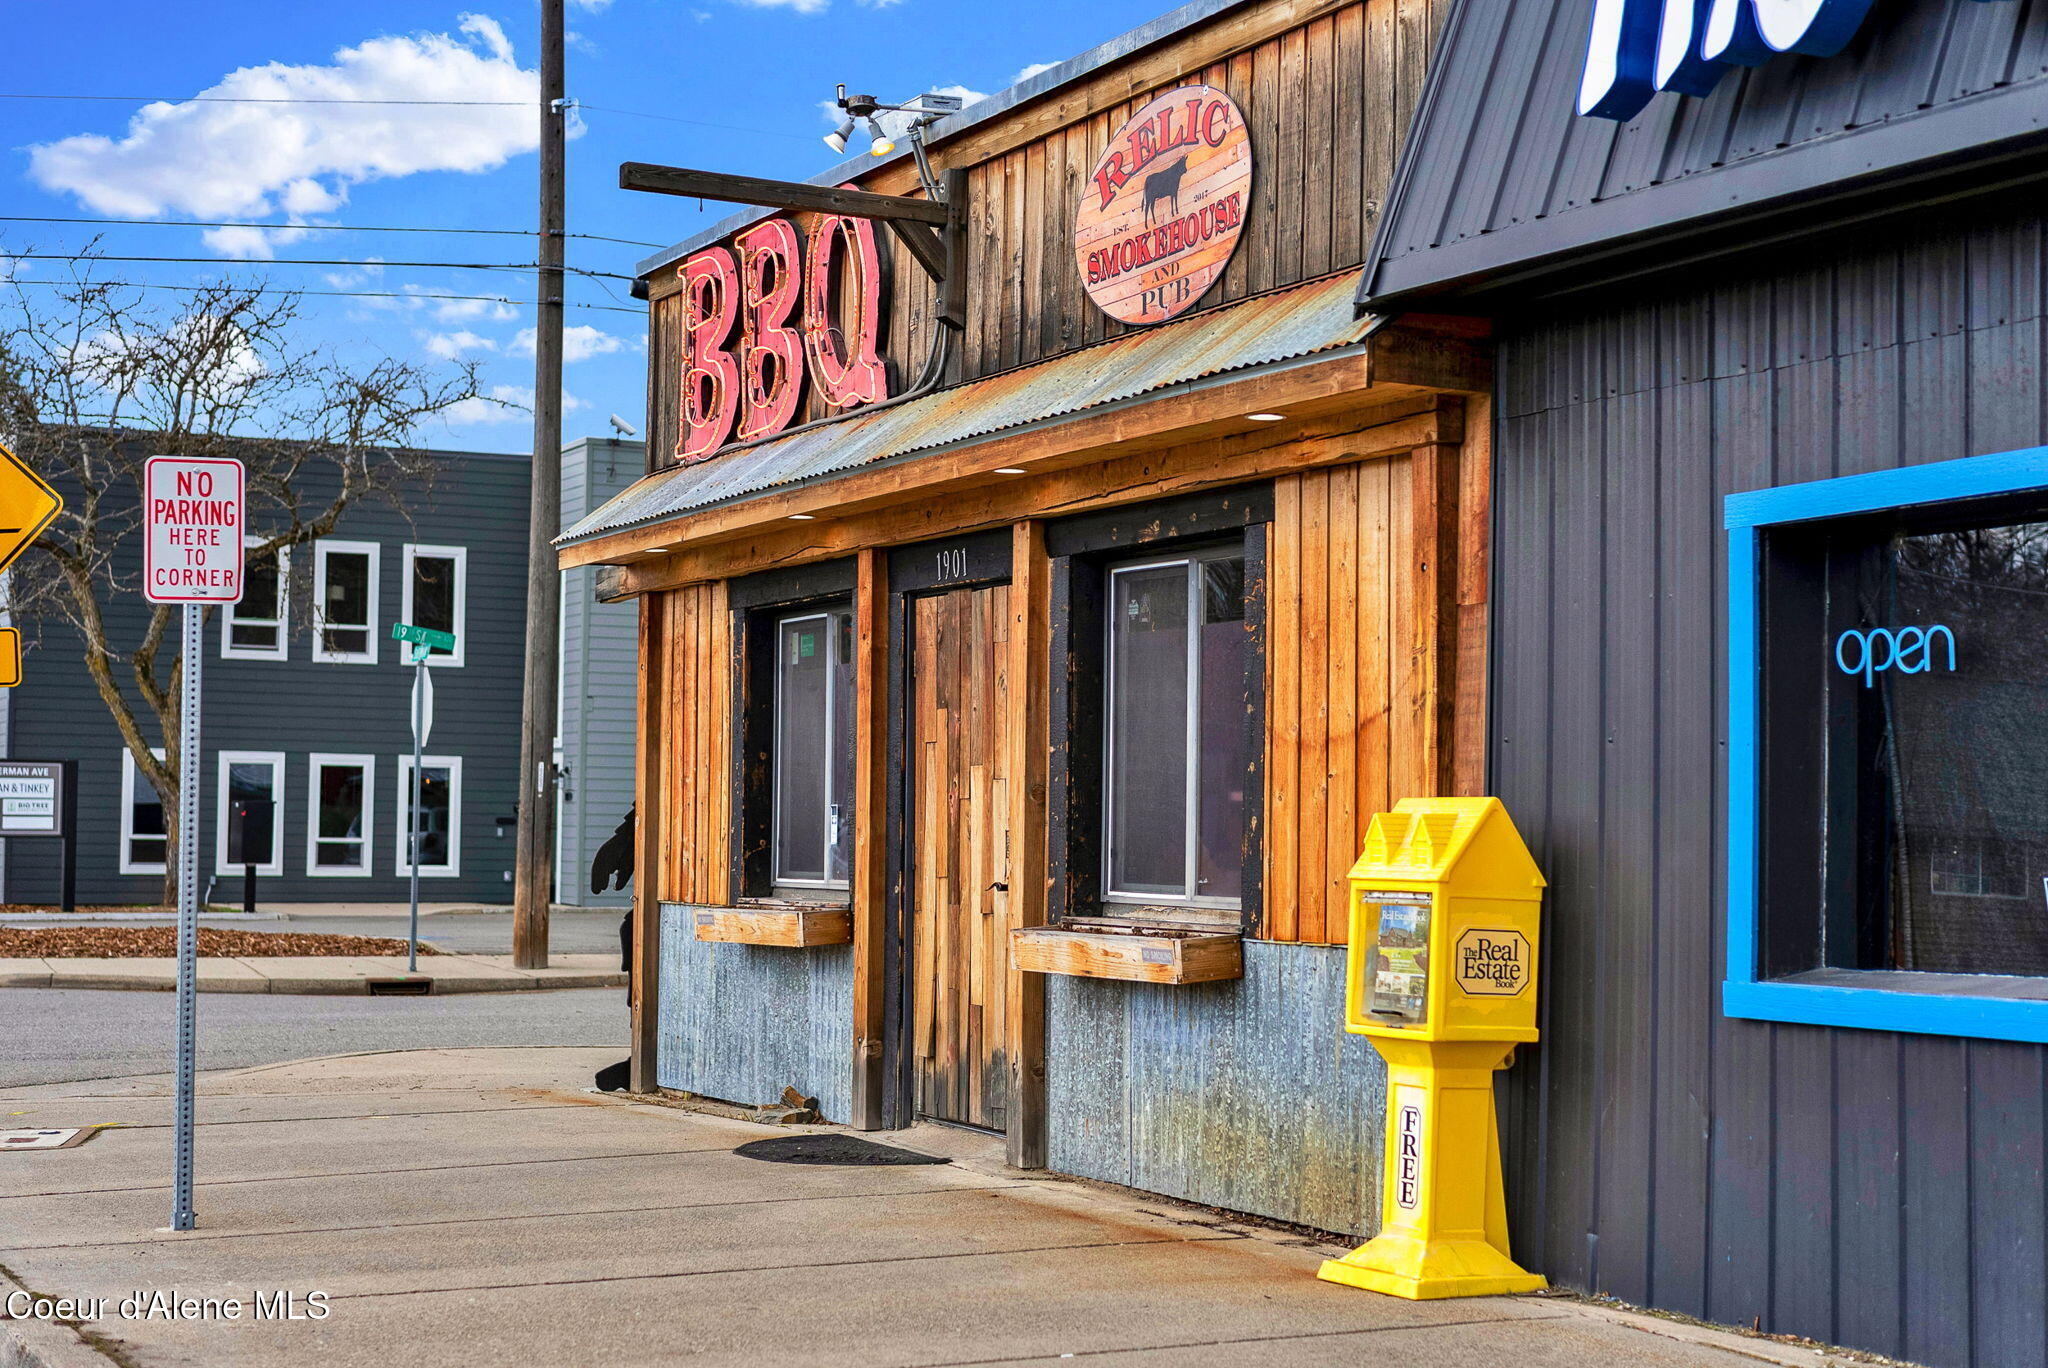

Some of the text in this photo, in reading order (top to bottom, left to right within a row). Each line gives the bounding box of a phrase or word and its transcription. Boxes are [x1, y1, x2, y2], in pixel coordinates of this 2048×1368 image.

[1093, 98, 1230, 212] RELIC
[1087, 190, 1241, 287] SMOKEHOUSE
[1151, 261, 1180, 284] AND
[1140, 276, 1191, 316] PUB
[674, 185, 888, 460] BBQ
[176, 471, 214, 497] NO
[154, 499, 236, 527] PARKING
[169, 528, 221, 546] HERE
[184, 548, 206, 566] TO
[936, 547, 967, 581] 1901
[155, 568, 234, 587] CORNER
[1835, 624, 1956, 688] open
[31, 767, 49, 776] AVE
[11, 783, 18, 793] &
[20, 783, 50, 793] TINKEY
[1463, 938, 1519, 962] The Real
[1463, 956, 1520, 980] Estate
[1495, 979, 1515, 988] Book
[1400, 1109, 1418, 1204] FREE
